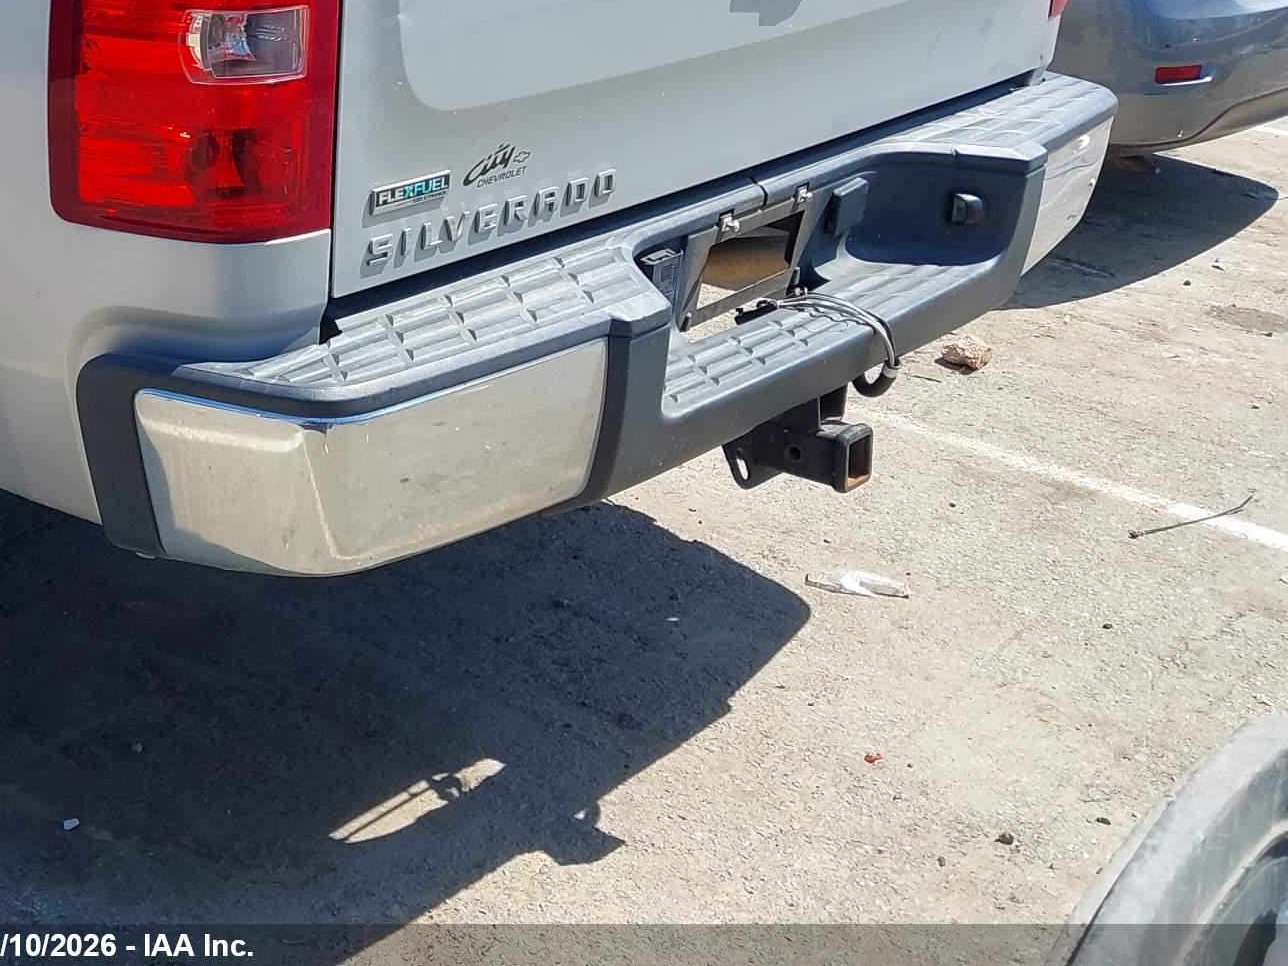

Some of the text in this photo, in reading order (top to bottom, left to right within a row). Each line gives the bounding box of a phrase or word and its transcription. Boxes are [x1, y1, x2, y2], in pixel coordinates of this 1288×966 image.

[462, 142, 516, 187] City
[476, 165, 529, 188] CHEVROLET
[378, 176, 449, 206] FLEXFUEL
[367, 168, 616, 267] SILVERADO
